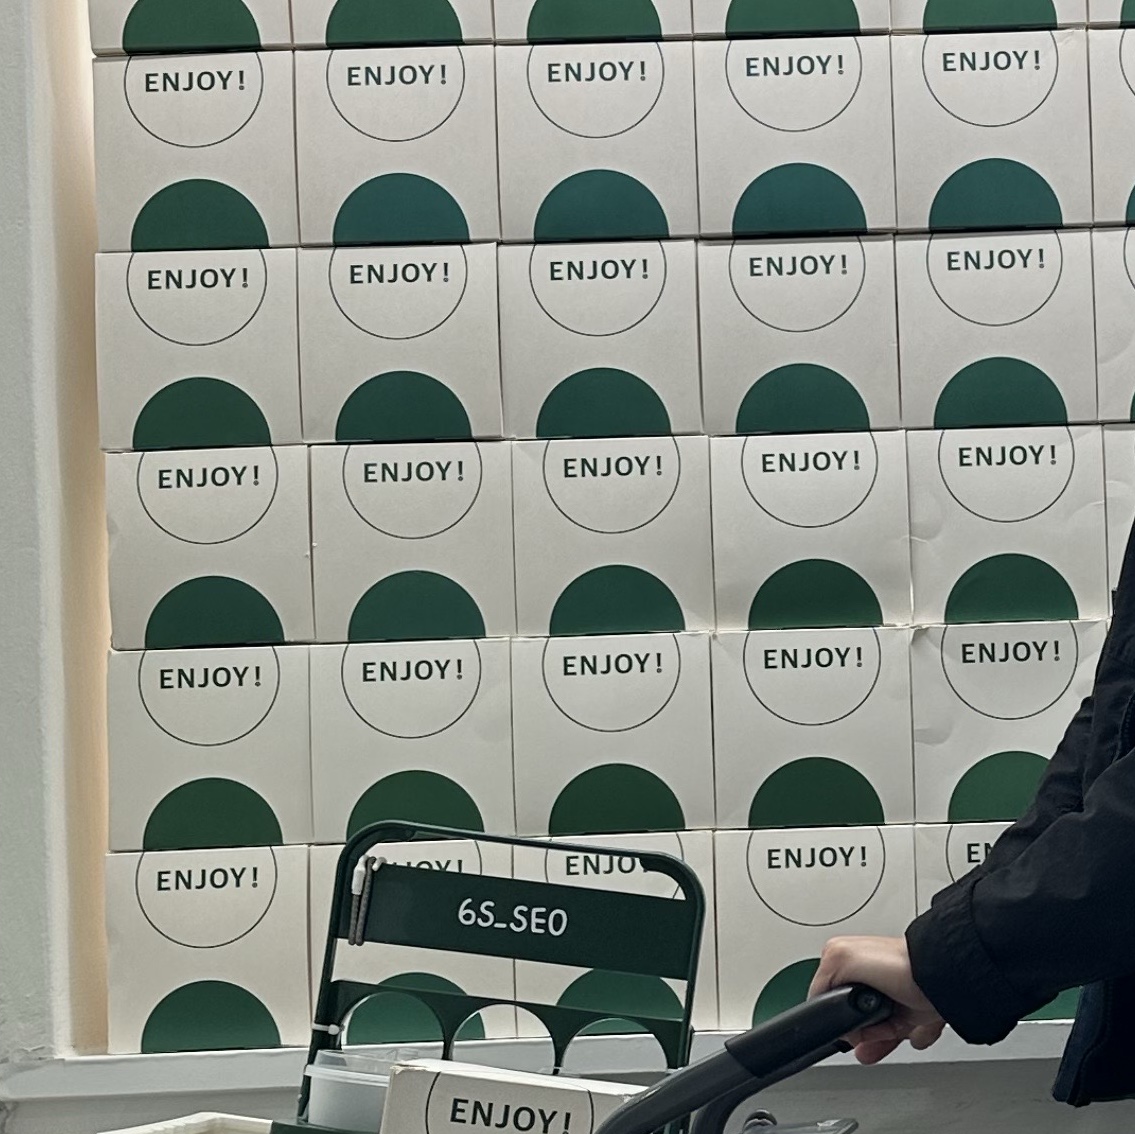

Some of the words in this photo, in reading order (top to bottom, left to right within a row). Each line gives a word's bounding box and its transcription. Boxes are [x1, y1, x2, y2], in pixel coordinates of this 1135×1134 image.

[548, 61, 645, 82] ENJOY!
[746, 55, 843, 76] ENJOY!
[943, 50, 1040, 71] ENJOY!
[146, 71, 244, 92] ENJOY!
[348, 65, 446, 86] ENJOY!
[550, 259, 648, 280] ENJOY!
[750, 255, 847, 276] ENJOY!
[947, 249, 1044, 271] ENJOY!
[148, 268, 248, 290] ENJOY!
[350, 263, 448, 284] ENJOY!
[564, 456, 662, 478] ENJOY!
[762, 451, 859, 472] ENJOY!
[959, 445, 1056, 467] ENJOY!
[159, 466, 259, 489] ENJOY!
[364, 461, 463, 482] ENJOY!
[764, 647, 862, 669] ENJOY!
[962, 641, 1060, 663] ENJOY!
[363, 659, 462, 682] ENJOY!
[563, 653, 662, 676] ENJOY!
[160, 666, 261, 689] ENJOY!
[566, 854, 647, 876] ENJO
[768, 846, 866, 869] ENJOY!
[157, 867, 257, 891] ENJOY!
